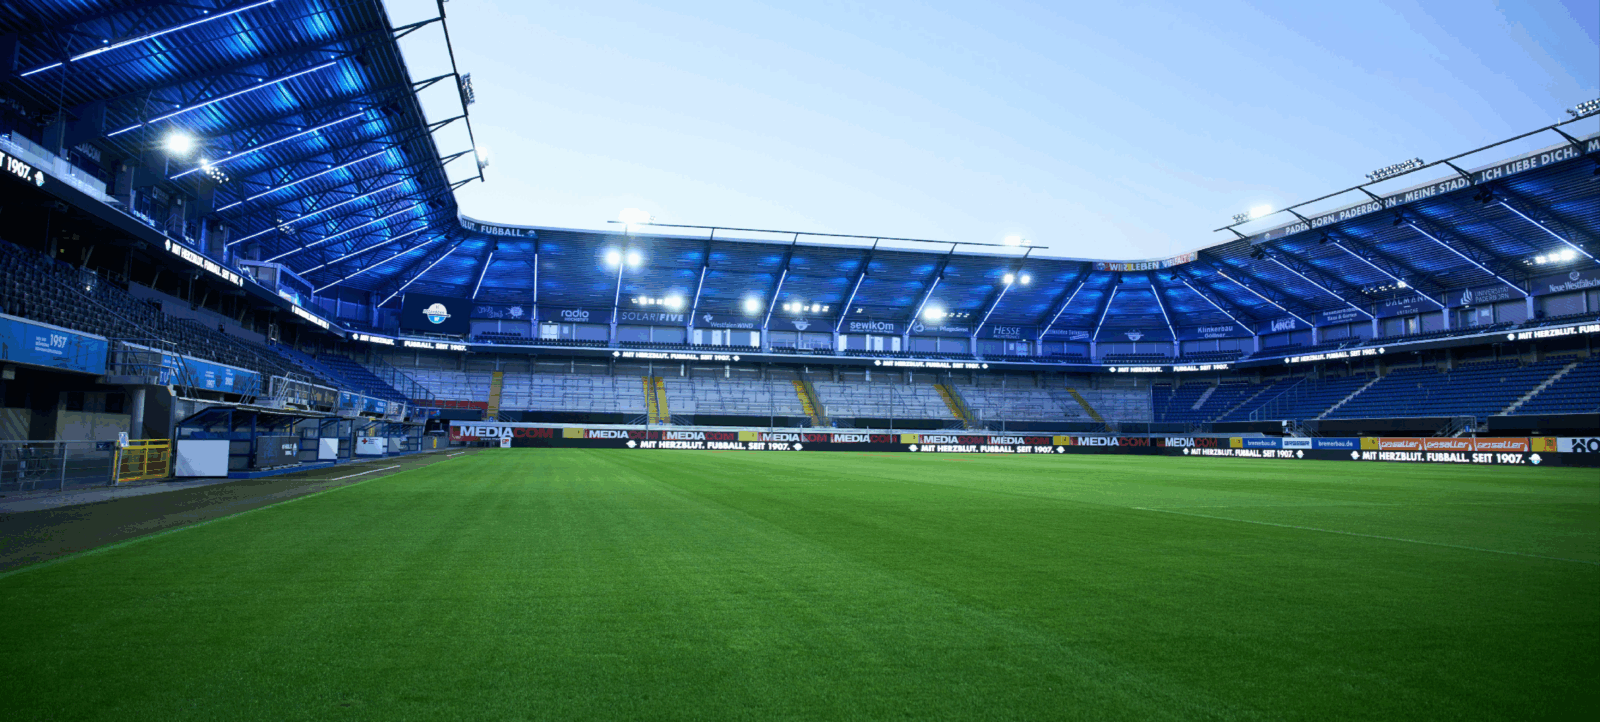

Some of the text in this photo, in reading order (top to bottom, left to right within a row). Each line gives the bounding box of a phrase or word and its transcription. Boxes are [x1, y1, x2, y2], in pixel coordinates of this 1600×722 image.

[7, 156, 31, 181] 1907.
[1286, 214, 1337, 235] PADERBORN,
[1340, 197, 1396, 220] PADERBORN
[1405, 186, 1436, 203] MEINE
[1482, 167, 1502, 182] ICH
[1506, 157, 1537, 175] LIEBE
[1541, 147, 1578, 165] DICH.
[1109, 263, 1128, 271] WIR
[1131, 261, 1159, 271] LEBEN
[1549, 283, 1565, 292] Neue
[1385, 296, 1428, 307] DALMAN
[561, 307, 589, 317] radio
[1518, 331, 1533, 340] MIT
[1534, 327, 1577, 338] HERZBLUT.
[50, 333, 68, 349] 1957
[460, 426, 554, 438] MEDIACOM
[589, 430, 659, 440] MEDIACOM
[666, 431, 735, 441] MEDIACOM
[835, 434, 897, 443] MEDIACOM
[923, 435, 984, 444] MEDIACOM
[991, 436, 1050, 445] MEDIACOM
[1078, 437, 1150, 447] MEDIACOM
[1165, 437, 1218, 447] MEDIACOM
[640, 440, 657, 449] MIT
[658, 441, 705, 449] HERZBLUT.
[768, 443, 790, 451] 1907.
[937, 445, 978, 453] HERZBLUT.
[1034, 446, 1054, 454] 1907.
[1277, 450, 1294, 458] 1907.
[1362, 451, 1377, 460] MIT
[1379, 451, 1425, 461] HERZBLUT.
[1472, 453, 1493, 463] SEIT
[1496, 453, 1525, 464] 1907.
